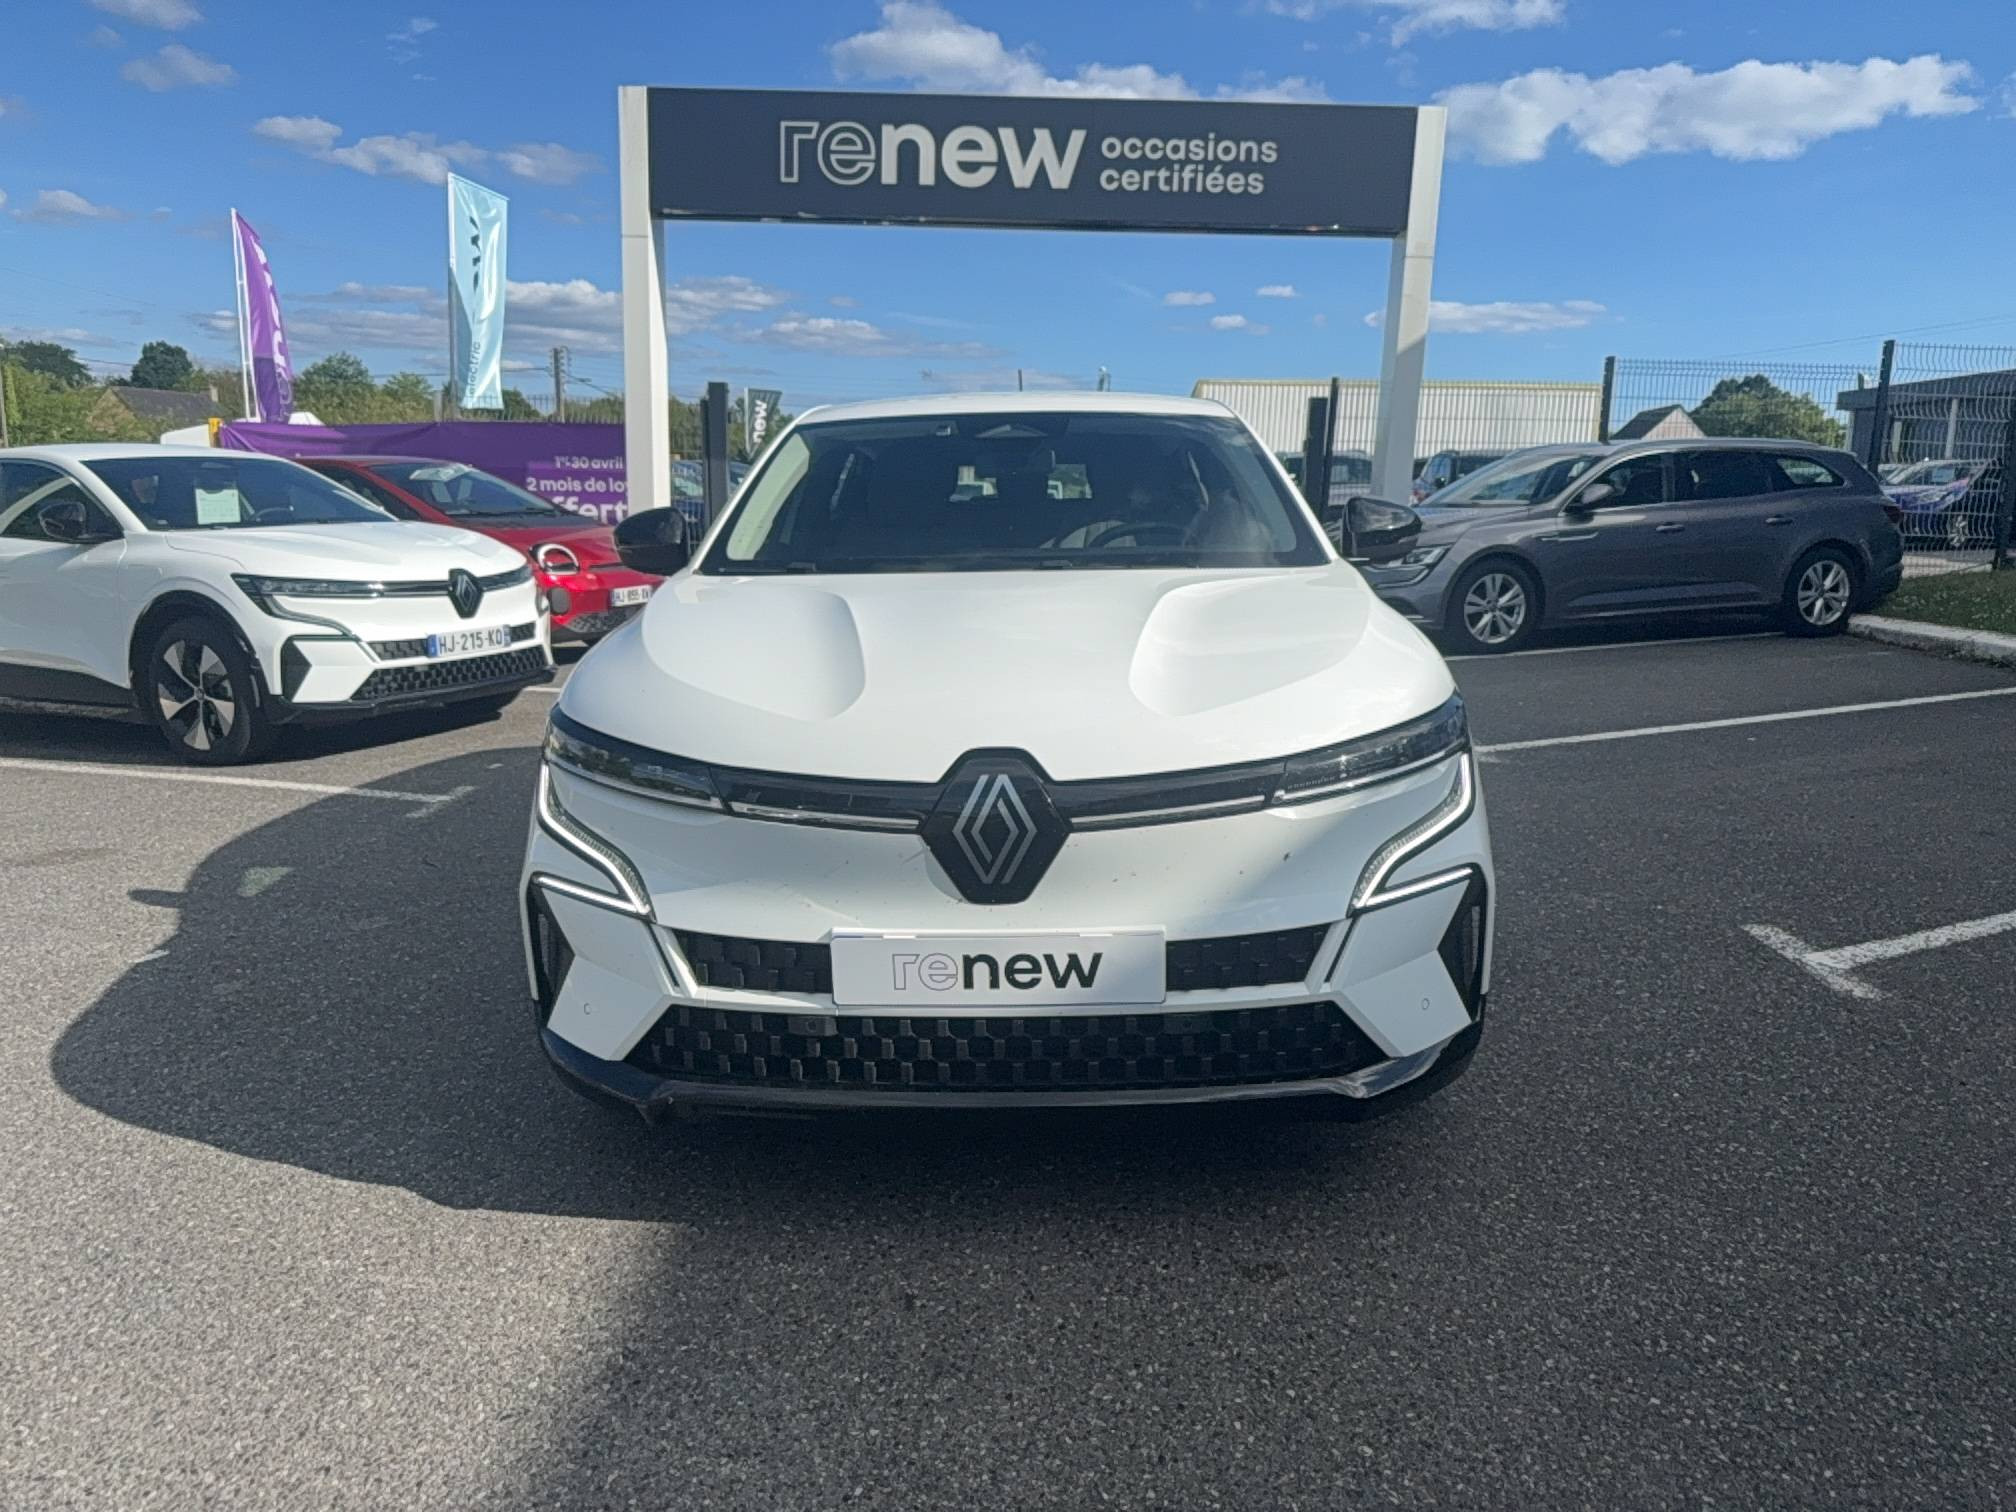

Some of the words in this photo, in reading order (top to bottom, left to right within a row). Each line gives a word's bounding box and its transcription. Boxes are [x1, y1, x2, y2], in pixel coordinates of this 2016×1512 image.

[780, 120, 1087, 189] renew
[1101, 132, 1278, 162] occasions
[1100, 164, 1265, 194] certifiées
[591, 456, 623, 469] avril
[526, 477, 537, 491] 2
[540, 477, 582, 492] mois
[584, 477, 606, 492] de
[609, 478, 626, 492] lo
[892, 952, 1103, 991] renew
